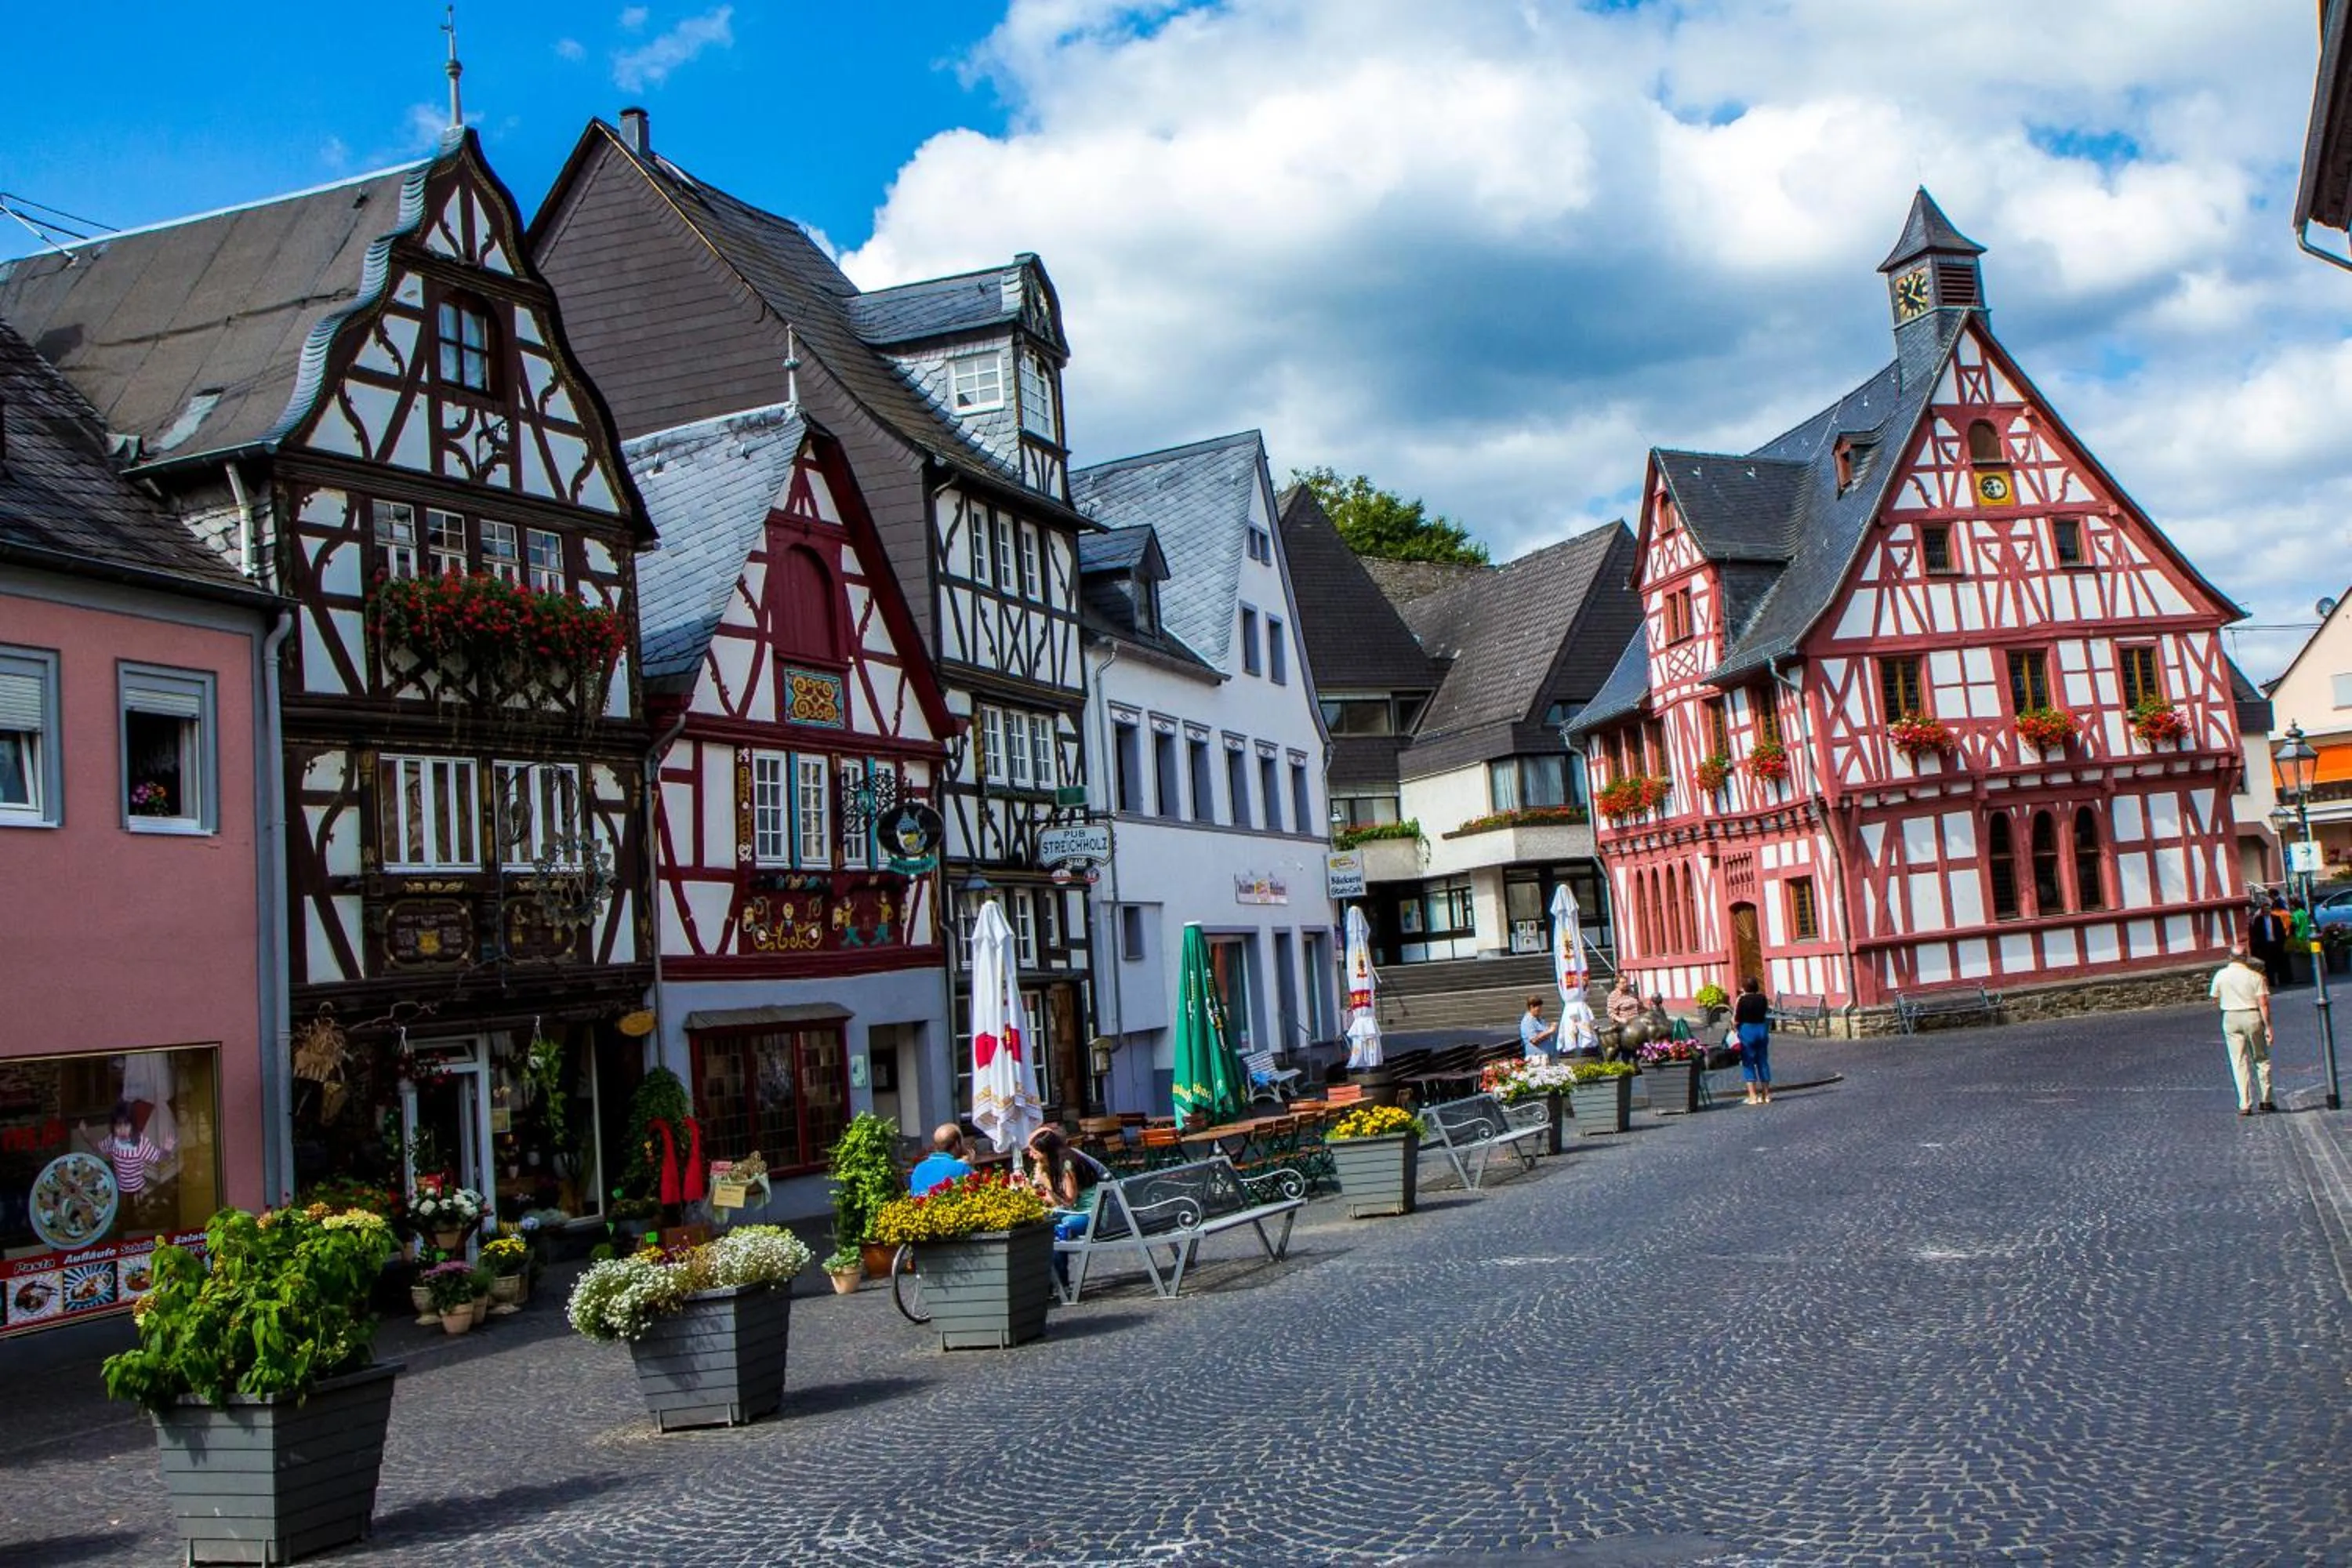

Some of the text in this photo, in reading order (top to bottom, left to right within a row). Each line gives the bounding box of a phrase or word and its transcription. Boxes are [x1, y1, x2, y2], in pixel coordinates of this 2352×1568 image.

[1063, 829, 1086, 838] PUB
[1042, 837, 1108, 854] STREICHHOLZ
[64, 1247, 117, 1265] Aufläufe
[14, 1258, 56, 1275] Pasta
